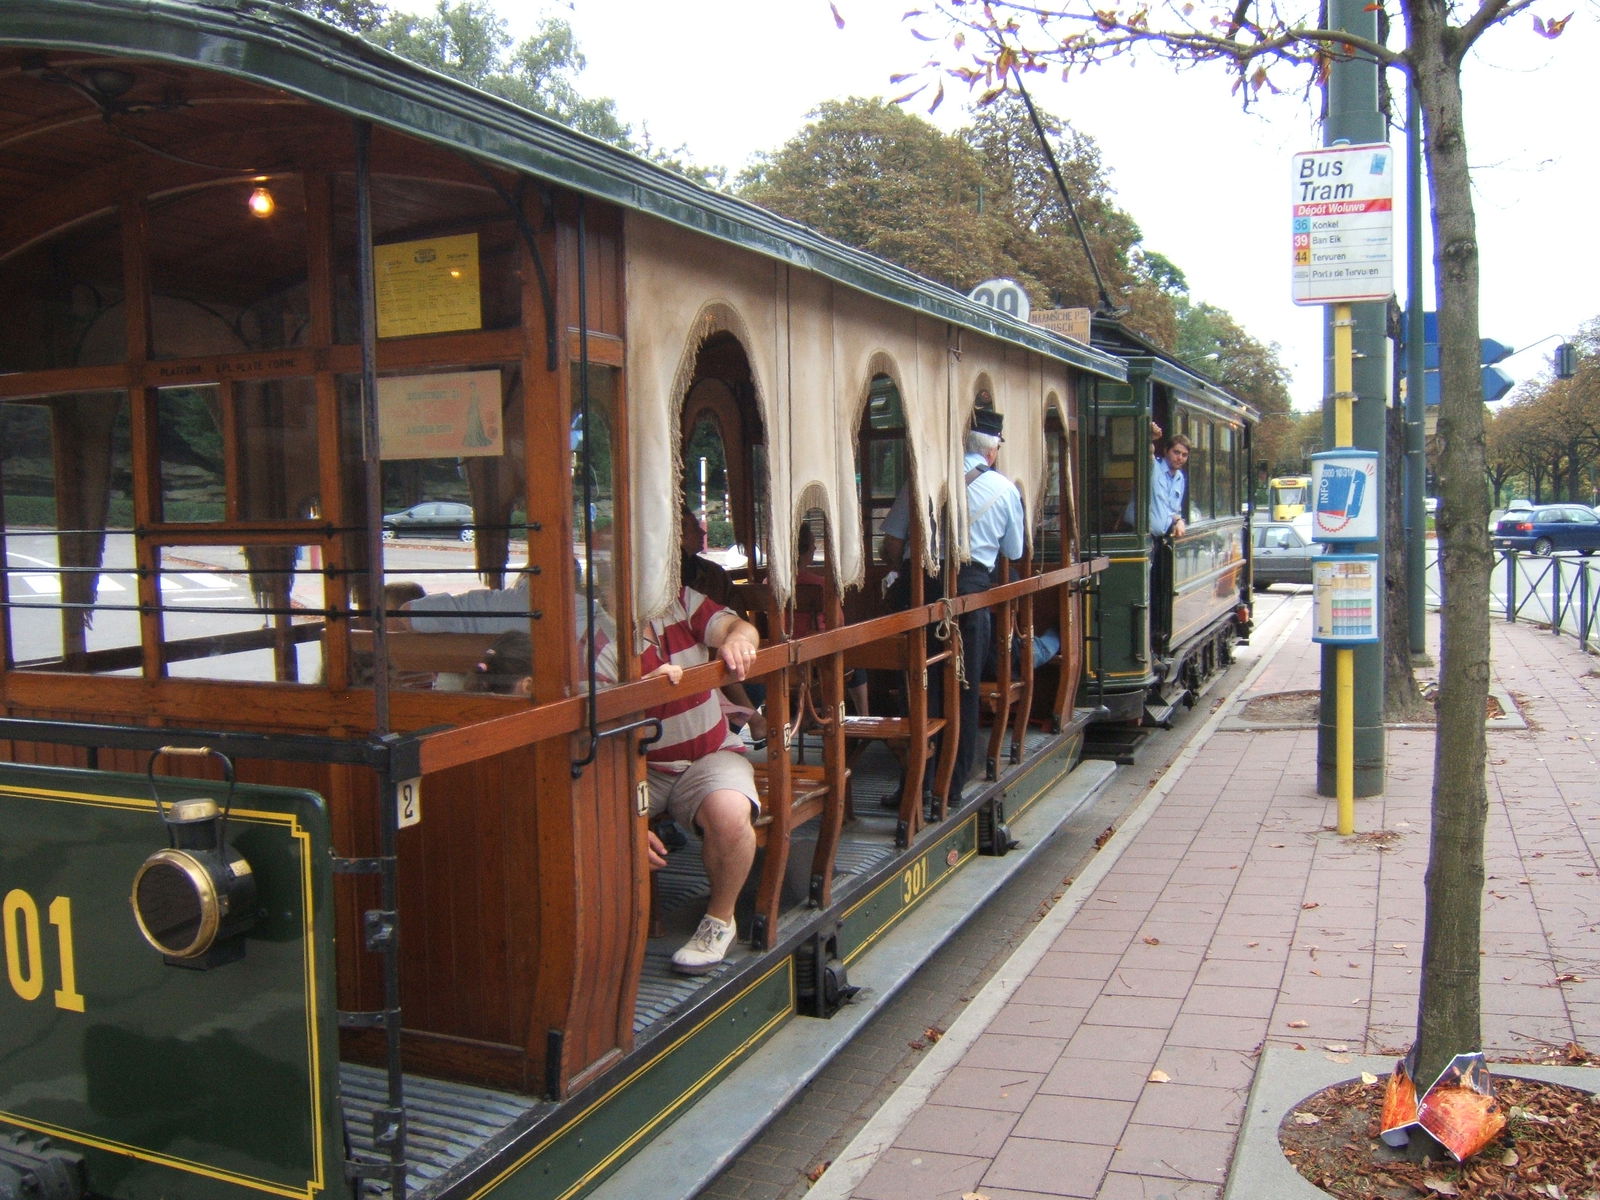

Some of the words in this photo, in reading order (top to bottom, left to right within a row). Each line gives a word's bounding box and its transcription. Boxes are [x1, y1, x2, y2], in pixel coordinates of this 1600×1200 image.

[1299, 157, 1343, 179] Bus
[1299, 181, 1354, 202] Tram
[1328, 203, 1365, 214] Woluwe
[1294, 219, 1308, 231] 36
[1312, 220, 1339, 230] Konkel
[1294, 235, 1308, 248] 39
[1329, 235, 1342, 244] Eik
[1295, 251, 1308, 263] 44
[1312, 252, 1346, 263] Tervuren
[1320, 478, 1329, 504] INFO
[403, 783, 414, 820] 2
[640, 785, 648, 812] 1
[903, 856, 927, 904] 301
[3, 888, 86, 1013] 01
